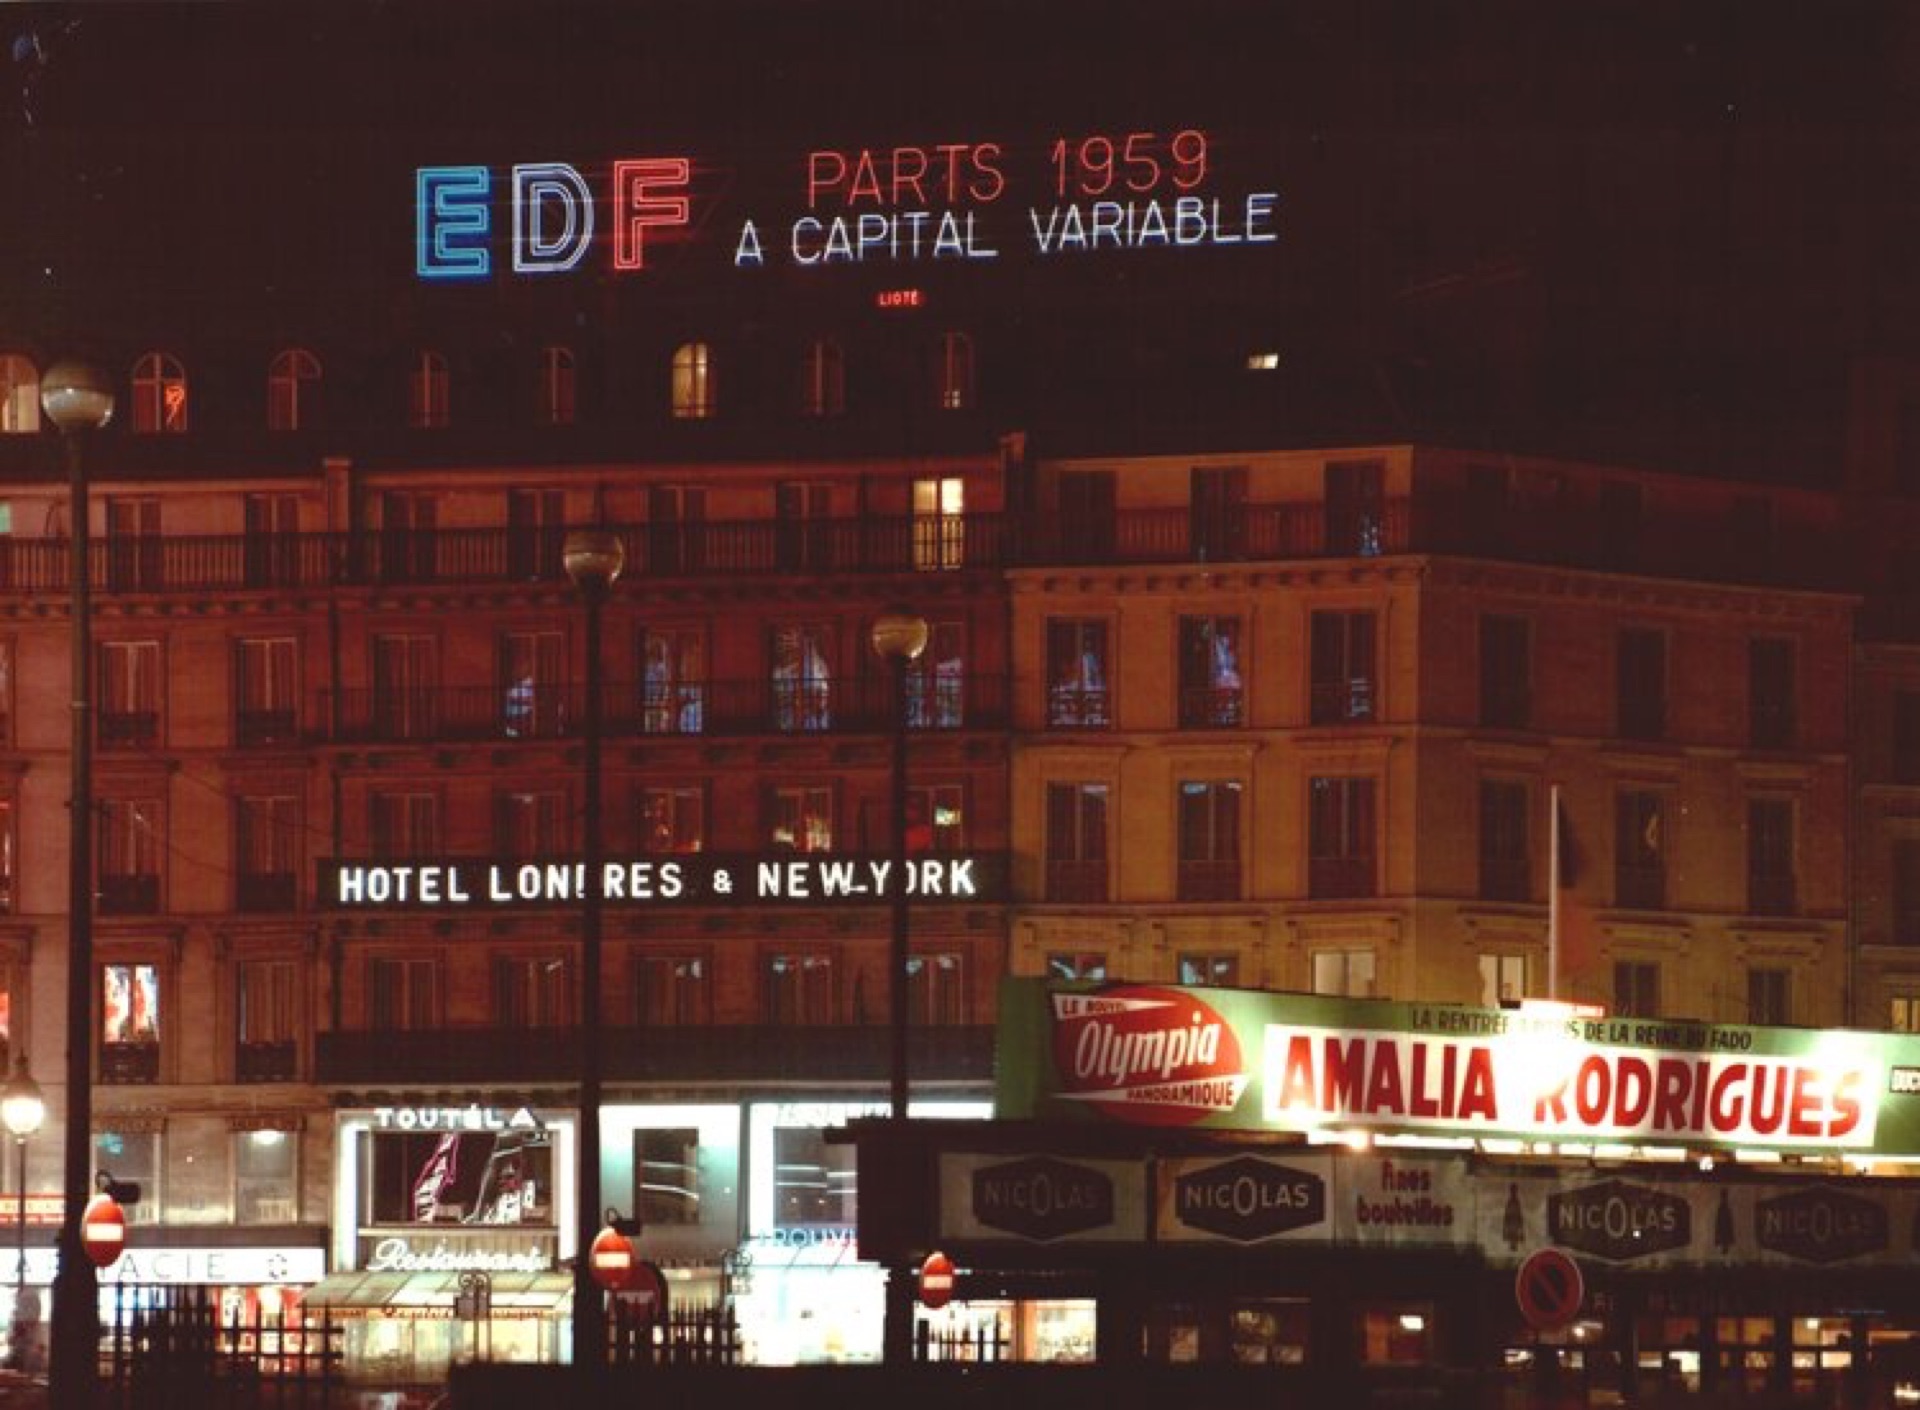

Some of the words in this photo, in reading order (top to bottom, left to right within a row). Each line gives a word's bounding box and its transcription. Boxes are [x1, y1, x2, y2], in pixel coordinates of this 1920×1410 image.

[807, 143, 1003, 207] PARTS
[1051, 130, 1208, 197] 1959
[416, 158, 689, 276] EDF
[791, 211, 999, 265] CAPITAL
[1031, 192, 1279, 253] VARIABLE
[340, 866, 469, 901] HOTEL
[712, 869, 733, 894] &
[1076, 1010, 1221, 1085] Olympia
[1412, 1008, 1432, 1030] LA
[1585, 1021, 1605, 1042] DE
[1610, 1023, 1629, 1043] LA
[1711, 1029, 1752, 1050] FADO
[1280, 1034, 1497, 1120] AMALIA
[985, 1174, 1099, 1217] NICOLAS
[1186, 1176, 1309, 1216] NICOLAS
[1559, 1197, 1675, 1238] NICOLAS
